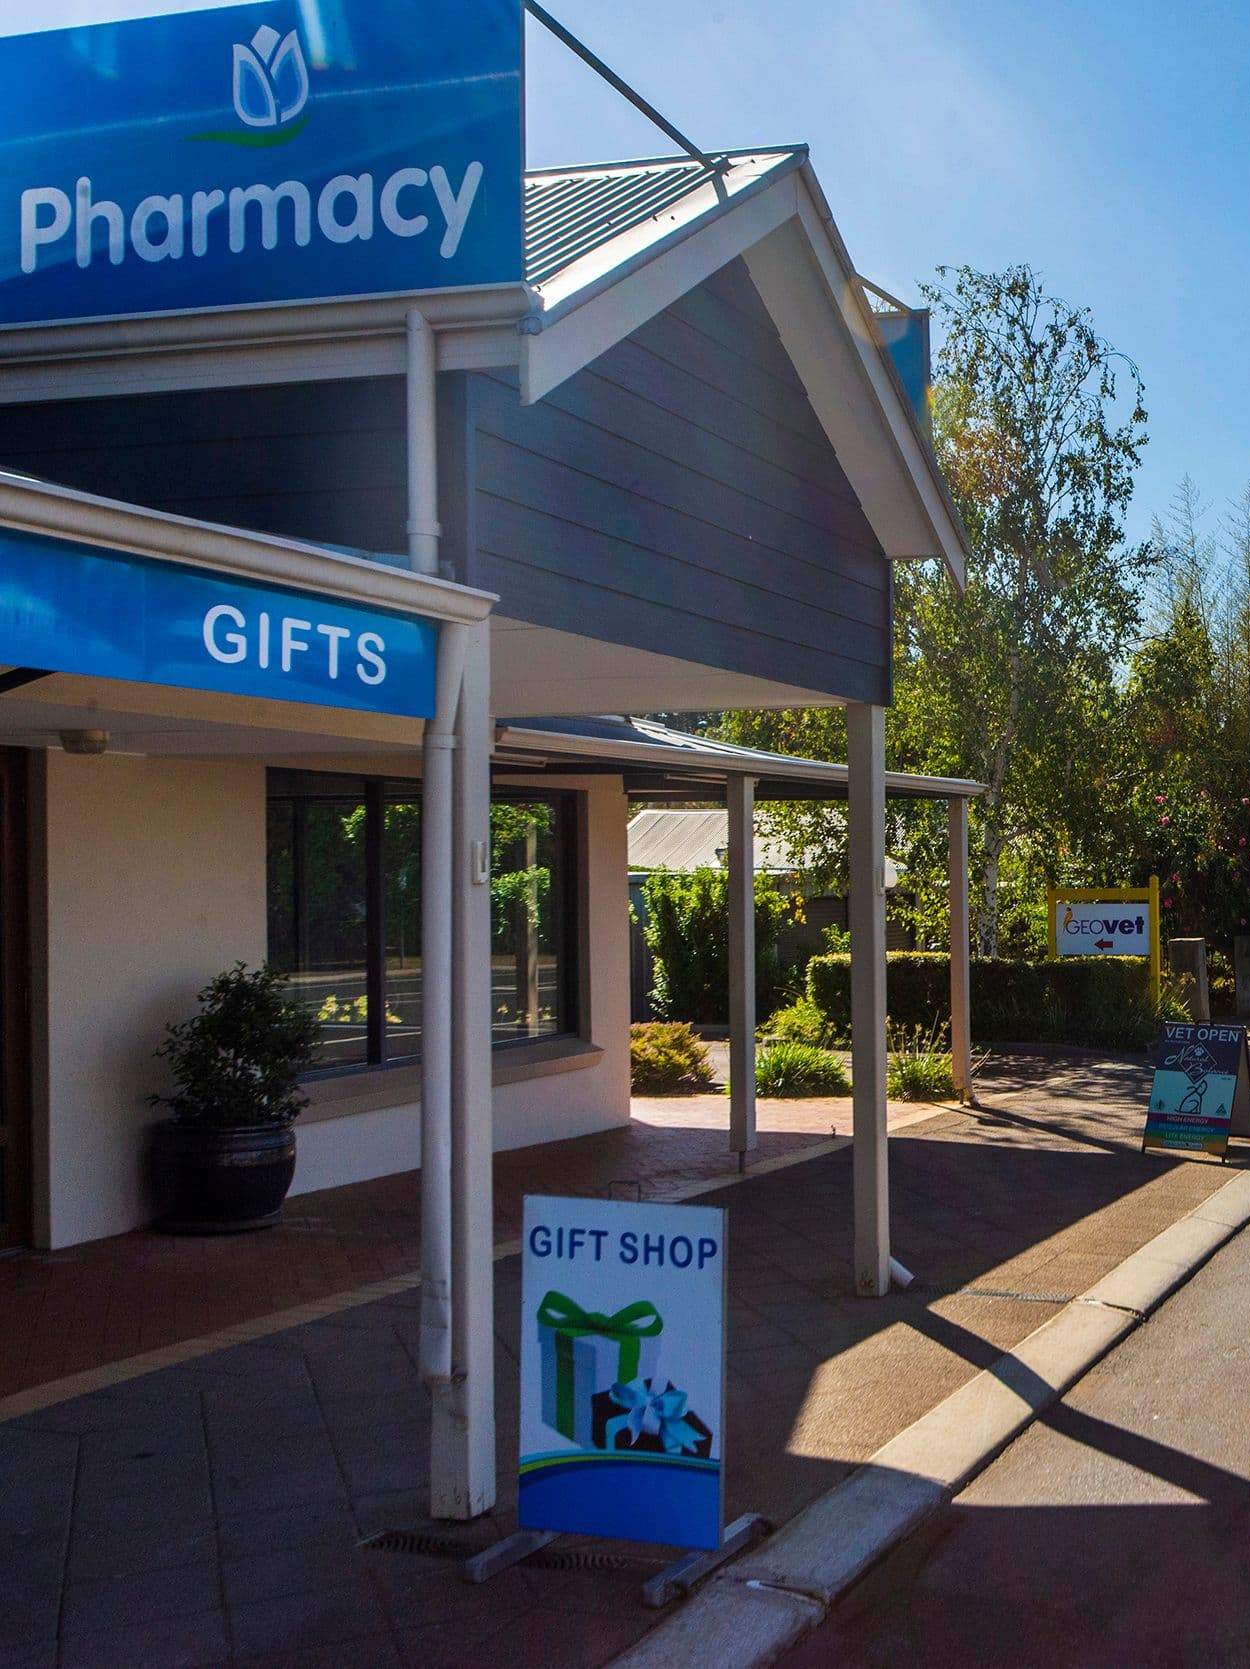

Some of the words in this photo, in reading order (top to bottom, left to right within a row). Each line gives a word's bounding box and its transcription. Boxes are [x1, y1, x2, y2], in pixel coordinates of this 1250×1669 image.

[21, 160, 484, 274] Pharmacy
[202, 604, 387, 686] GIFTS
[1065, 915, 1145, 935] GEOvet
[1165, 1026, 1195, 1039] VET
[1197, 1028, 1239, 1042] OPEN
[1183, 1116, 1210, 1125] ENERGY
[529, 1225, 609, 1262] GIFT
[618, 1231, 718, 1270] SHOP
